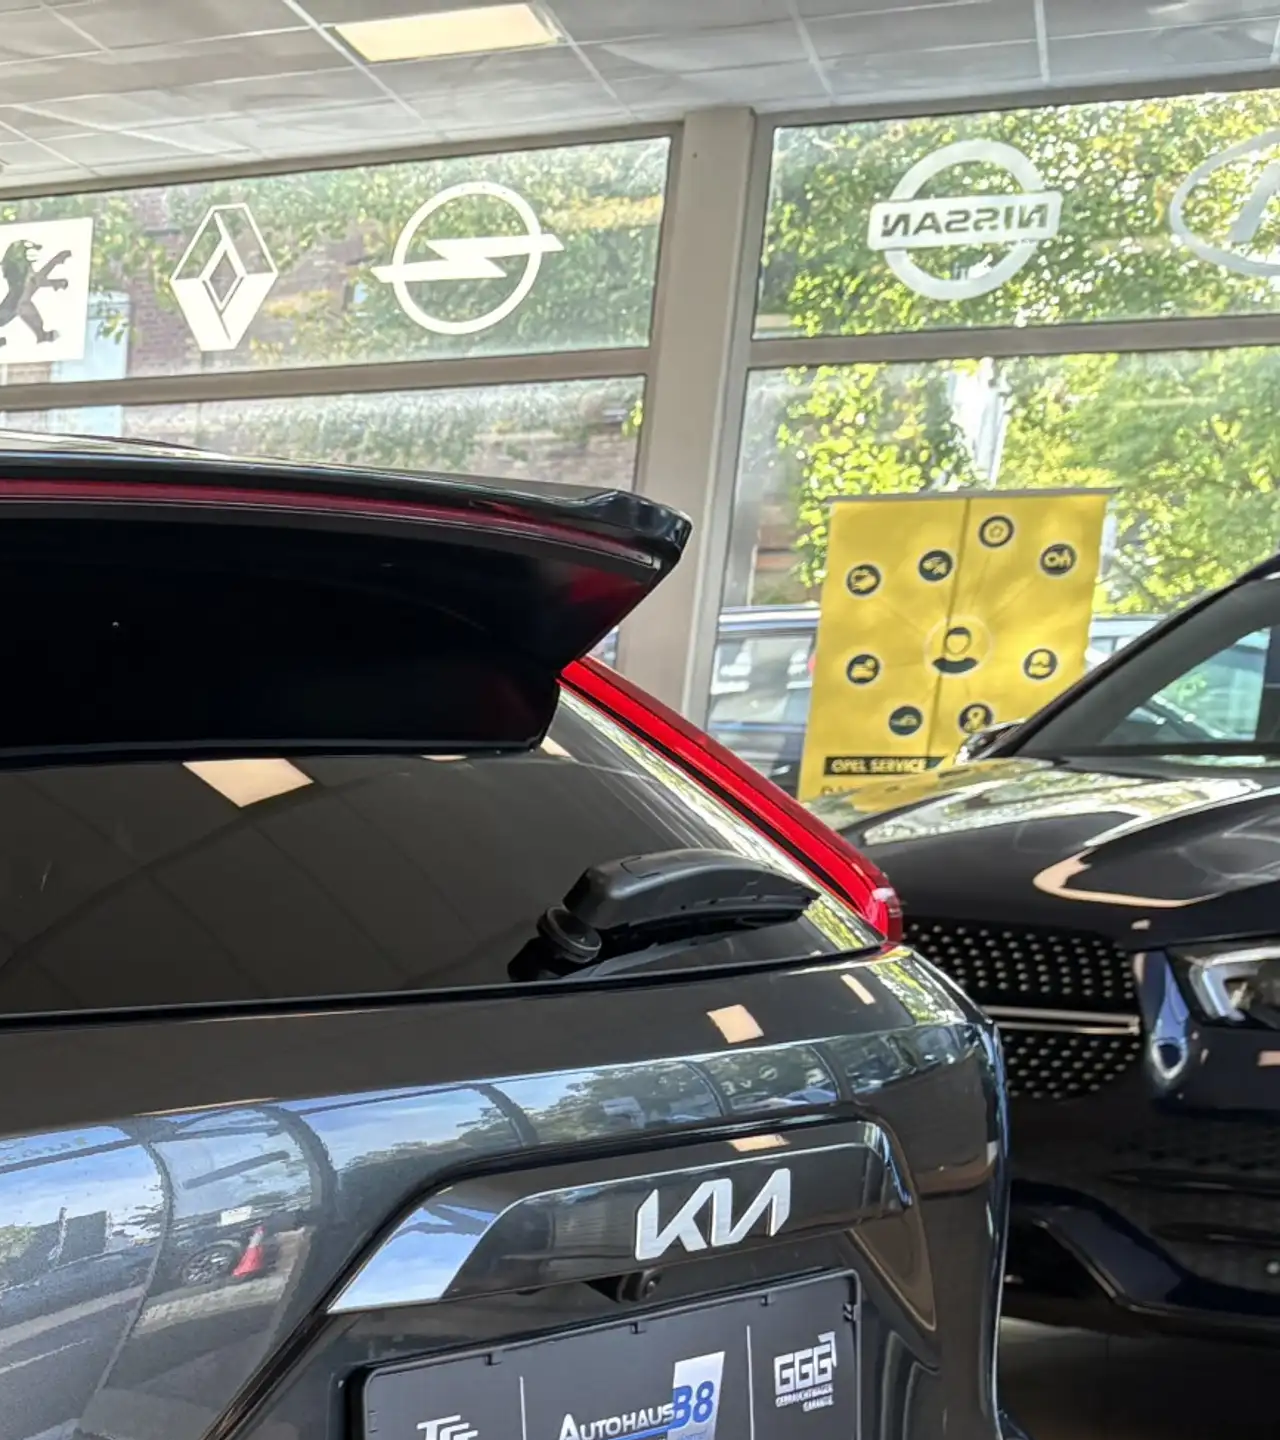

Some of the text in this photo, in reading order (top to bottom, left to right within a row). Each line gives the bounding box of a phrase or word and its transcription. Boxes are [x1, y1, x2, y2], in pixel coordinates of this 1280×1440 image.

[831, 758, 866, 773] OPEL
[634, 1167, 792, 1261] KIA
[672, 1380, 714, 1429] B8
